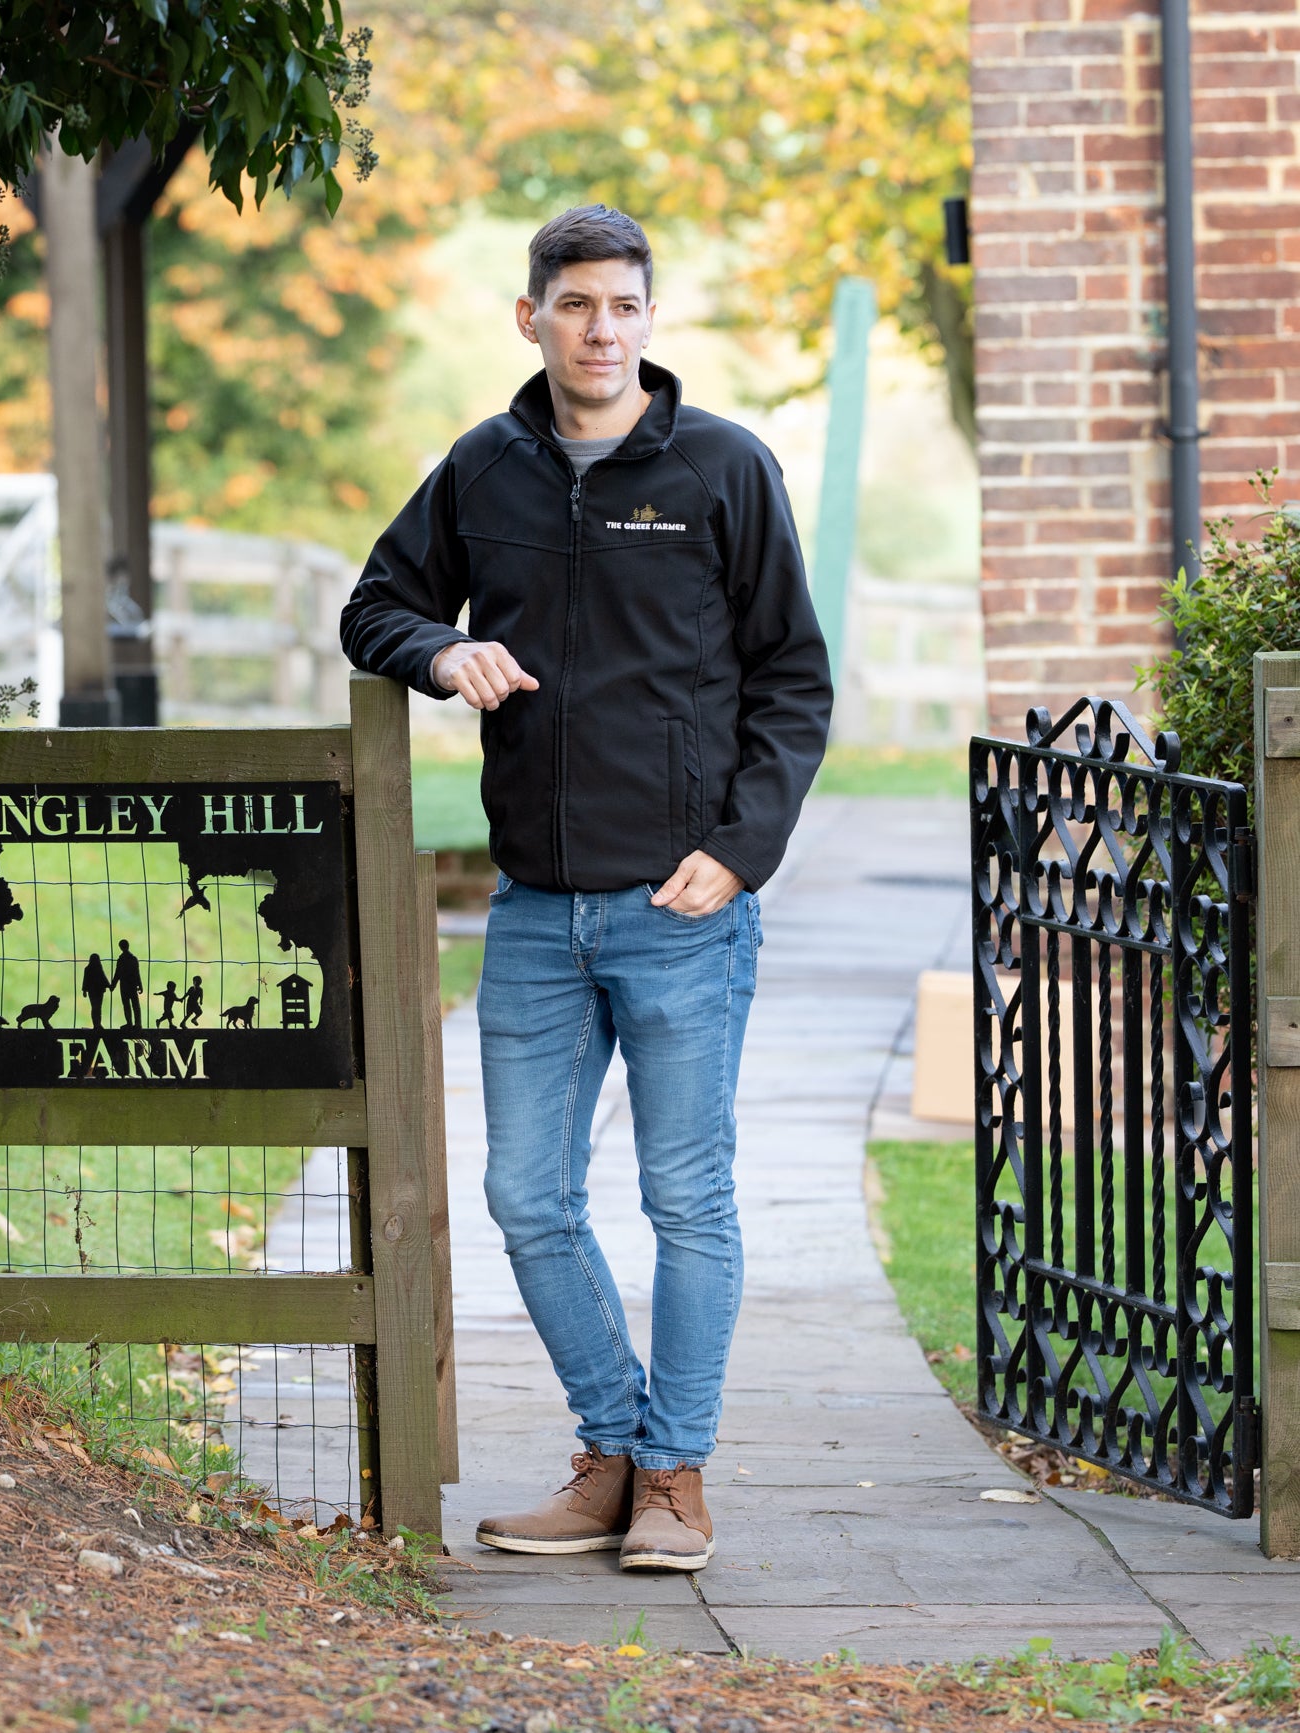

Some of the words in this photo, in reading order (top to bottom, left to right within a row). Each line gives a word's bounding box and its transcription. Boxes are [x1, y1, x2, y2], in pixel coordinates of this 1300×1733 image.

[606, 521, 622, 530] THE
[623, 521, 651, 531] GREEK
[652, 522, 686, 532] FARMER
[200, 794, 324, 835] HILL
[56, 1038, 209, 1080] FARM
